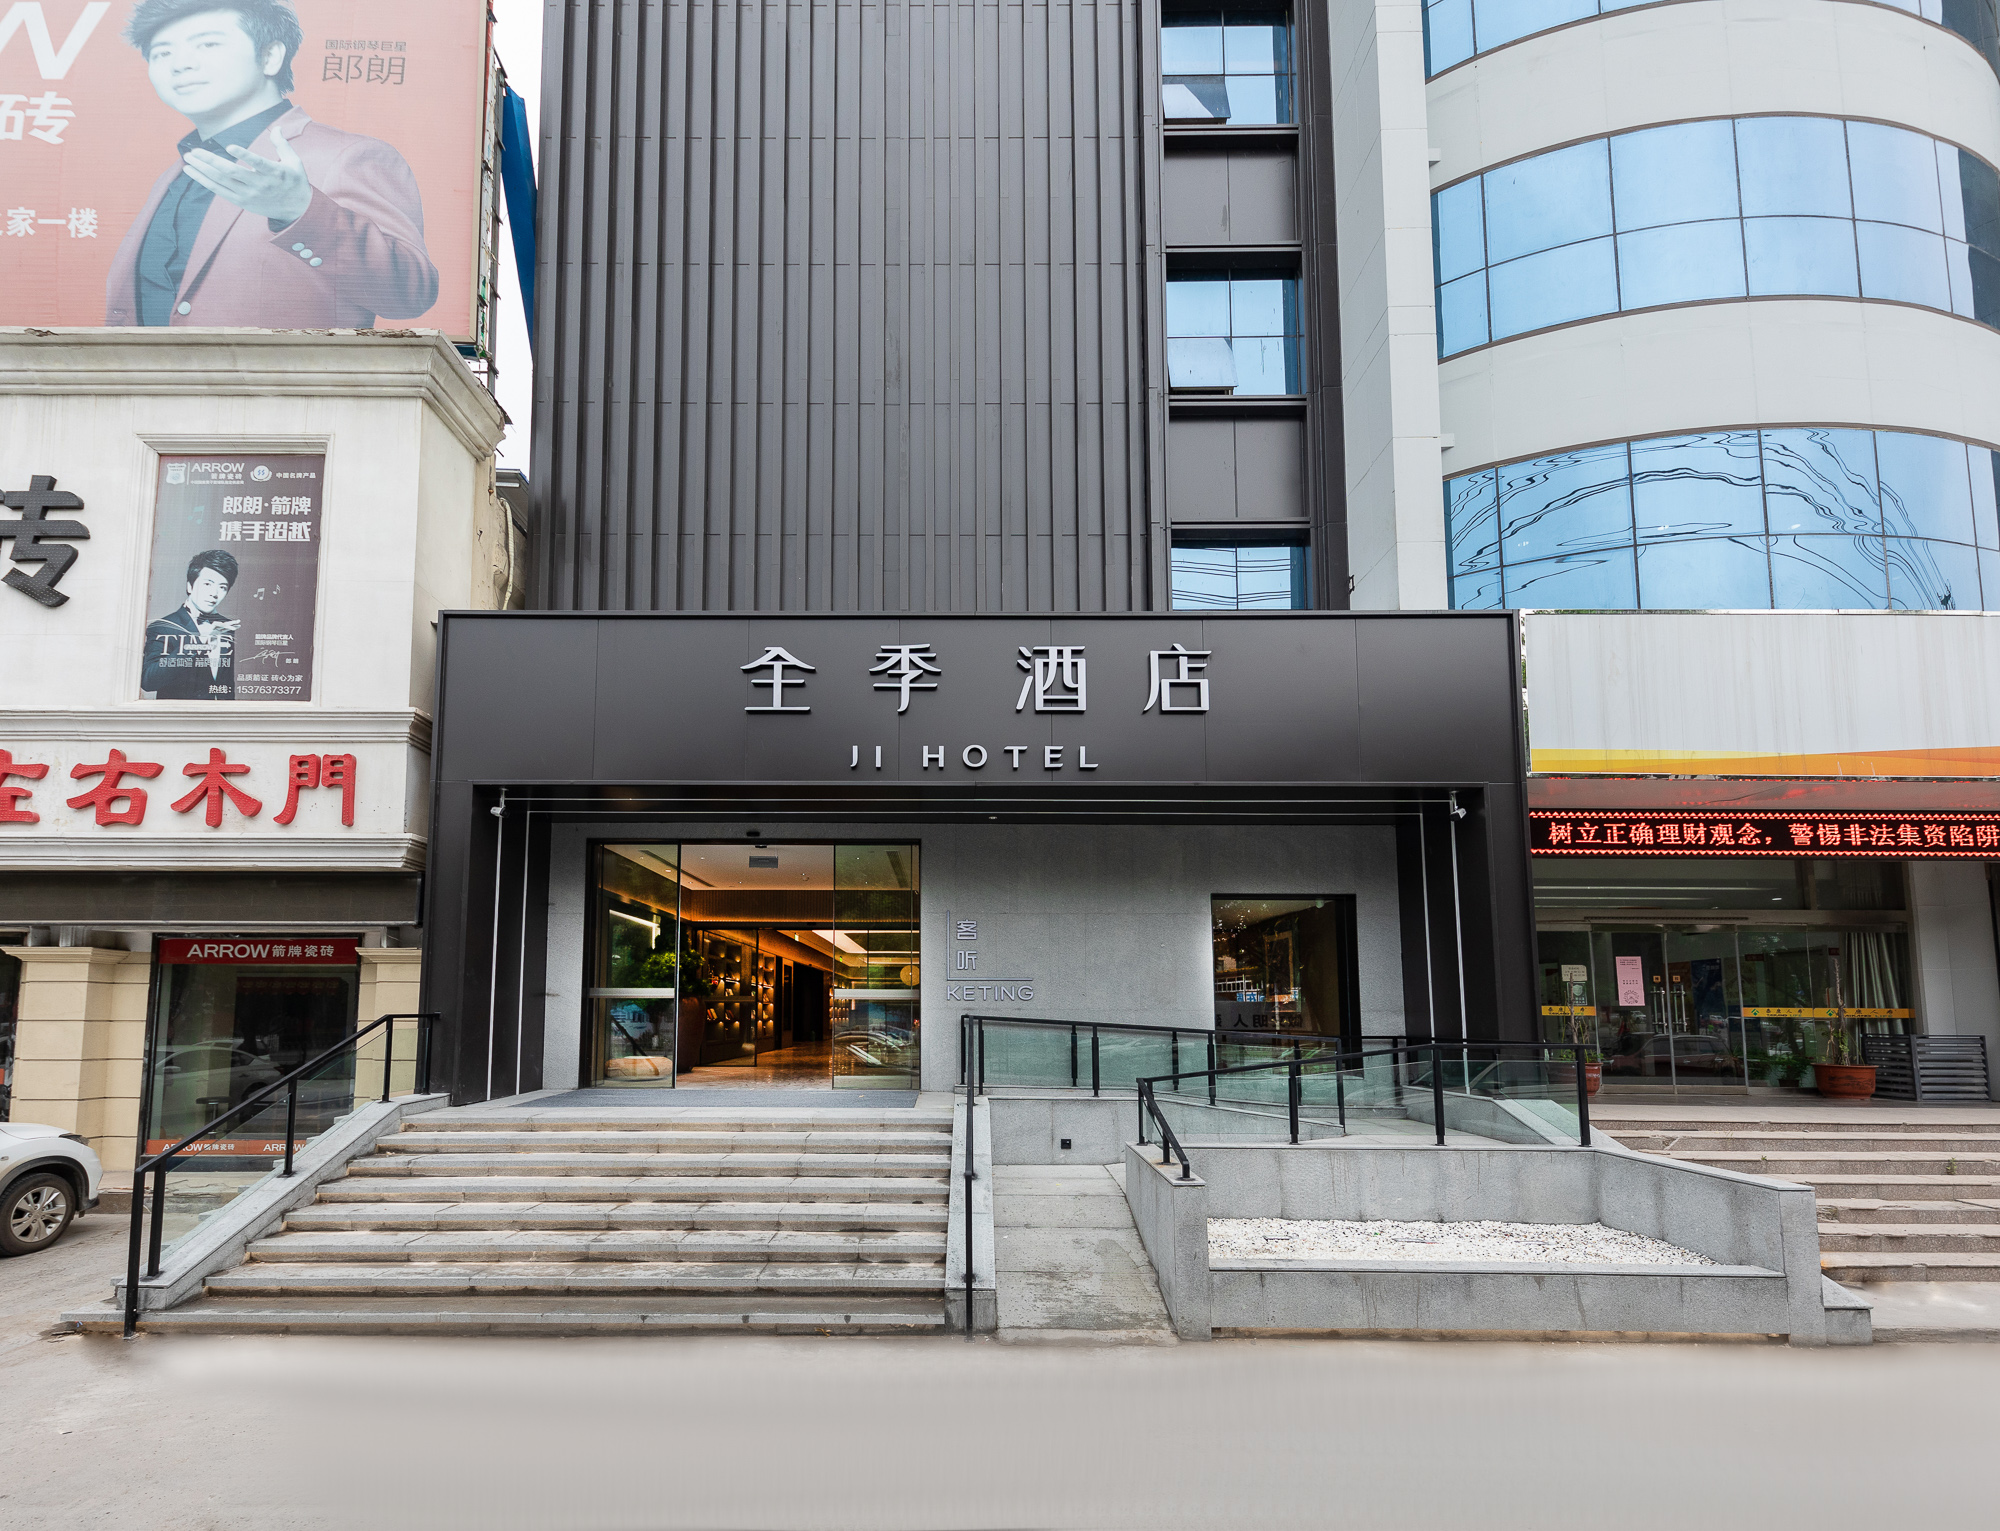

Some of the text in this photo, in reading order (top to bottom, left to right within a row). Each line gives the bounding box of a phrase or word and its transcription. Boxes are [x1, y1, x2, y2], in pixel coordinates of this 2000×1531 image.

[325, 39, 406, 52] 国际钢琴巨星
[322, 54, 406, 85] 郎朗
[0, 207, 99, 239] 家一楼
[191, 463, 245, 473] ARROW
[219, 521, 312, 542] 携手超越
[156, 634, 234, 656] TIME
[740, 643, 1211, 714] 全季酒店
[236, 686, 302, 695] 15376373377
[851, 744, 1100, 769] JI HOTEL
[187, 944, 335, 958] ARROW 箭牌瓷砖
[946, 985, 1034, 1001] KETING
